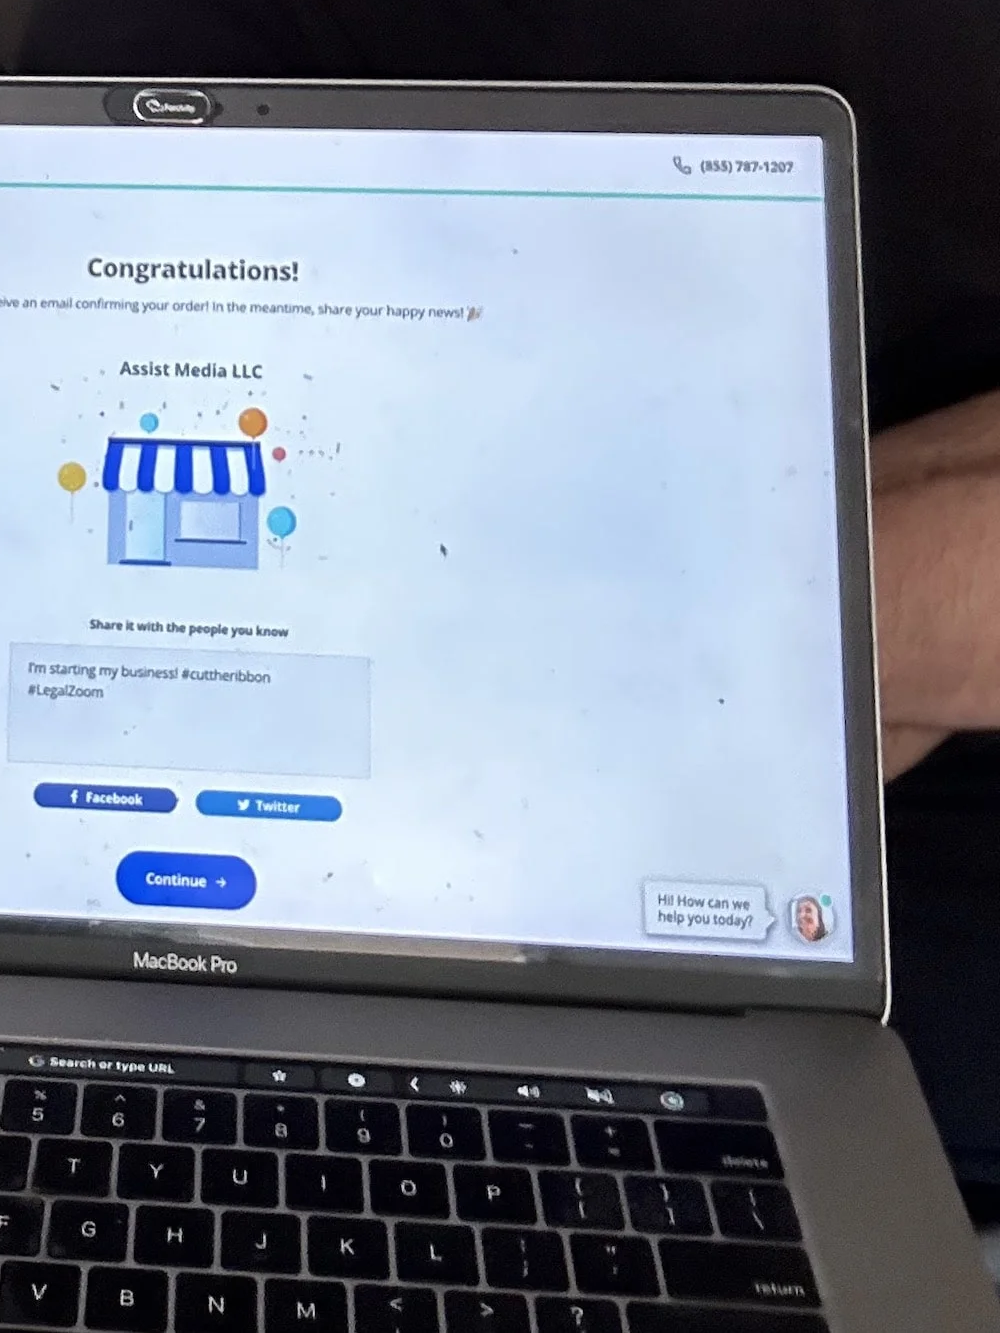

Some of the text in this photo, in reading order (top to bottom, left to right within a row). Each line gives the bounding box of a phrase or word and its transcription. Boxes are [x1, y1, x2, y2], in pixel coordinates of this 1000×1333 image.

[700, 159, 794, 174] (855) 787-1207
[87, 257, 299, 284] Congratulations!
[22, 298, 37, 309] an
[40, 296, 73, 310] email
[75, 297, 140, 314] confirming
[142, 301, 169, 314] your
[172, 299, 209, 313] order!
[212, 301, 224, 313] In
[226, 301, 247, 314] the
[249, 302, 316, 317] meantime,
[318, 303, 353, 317] share
[355, 306, 384, 319] your
[386, 304, 426, 321] happy
[428, 306, 465, 318] news!
[119, 360, 264, 379] Assist Media LLC
[89, 618, 290, 638] Share it with the people you know
[28, 661, 272, 684] I'm starting my business! #cuttheribbon
[28, 683, 105, 700] #LegalZoom
[85, 790, 144, 808] Facebook
[255, 798, 301, 815] Twitter
[145, 871, 208, 889] Continue
[657, 893, 751, 912] Hi! How can we
[657, 910, 754, 931] help you today?
[133, 950, 238, 974] MacBook Pro
[50, 1056, 96, 1069] Search
[99, 1060, 113, 1071] or
[115, 1060, 146, 1074] type
[148, 1062, 176, 1075] URL
[32, 1107, 44, 1122] 5
[111, 1112, 125, 1127] 6
[194, 1117, 206, 1132] 7
[67, 1157, 81, 1174] T
[149, 1163, 163, 1179] Y
[232, 1168, 248, 1185] U
[400, 1179, 417, 1196] O
[486, 1184, 501, 1200] P
[81, 1220, 97, 1238] G
[167, 1227, 183, 1243] H
[255, 1233, 267, 1250] J
[340, 1238, 355, 1255] K
[429, 1244, 442, 1261] L
[31, 1283, 48, 1301] V
[119, 1289, 135, 1307] B
[208, 1295, 225, 1314] N
[296, 1301, 316, 1319] M
